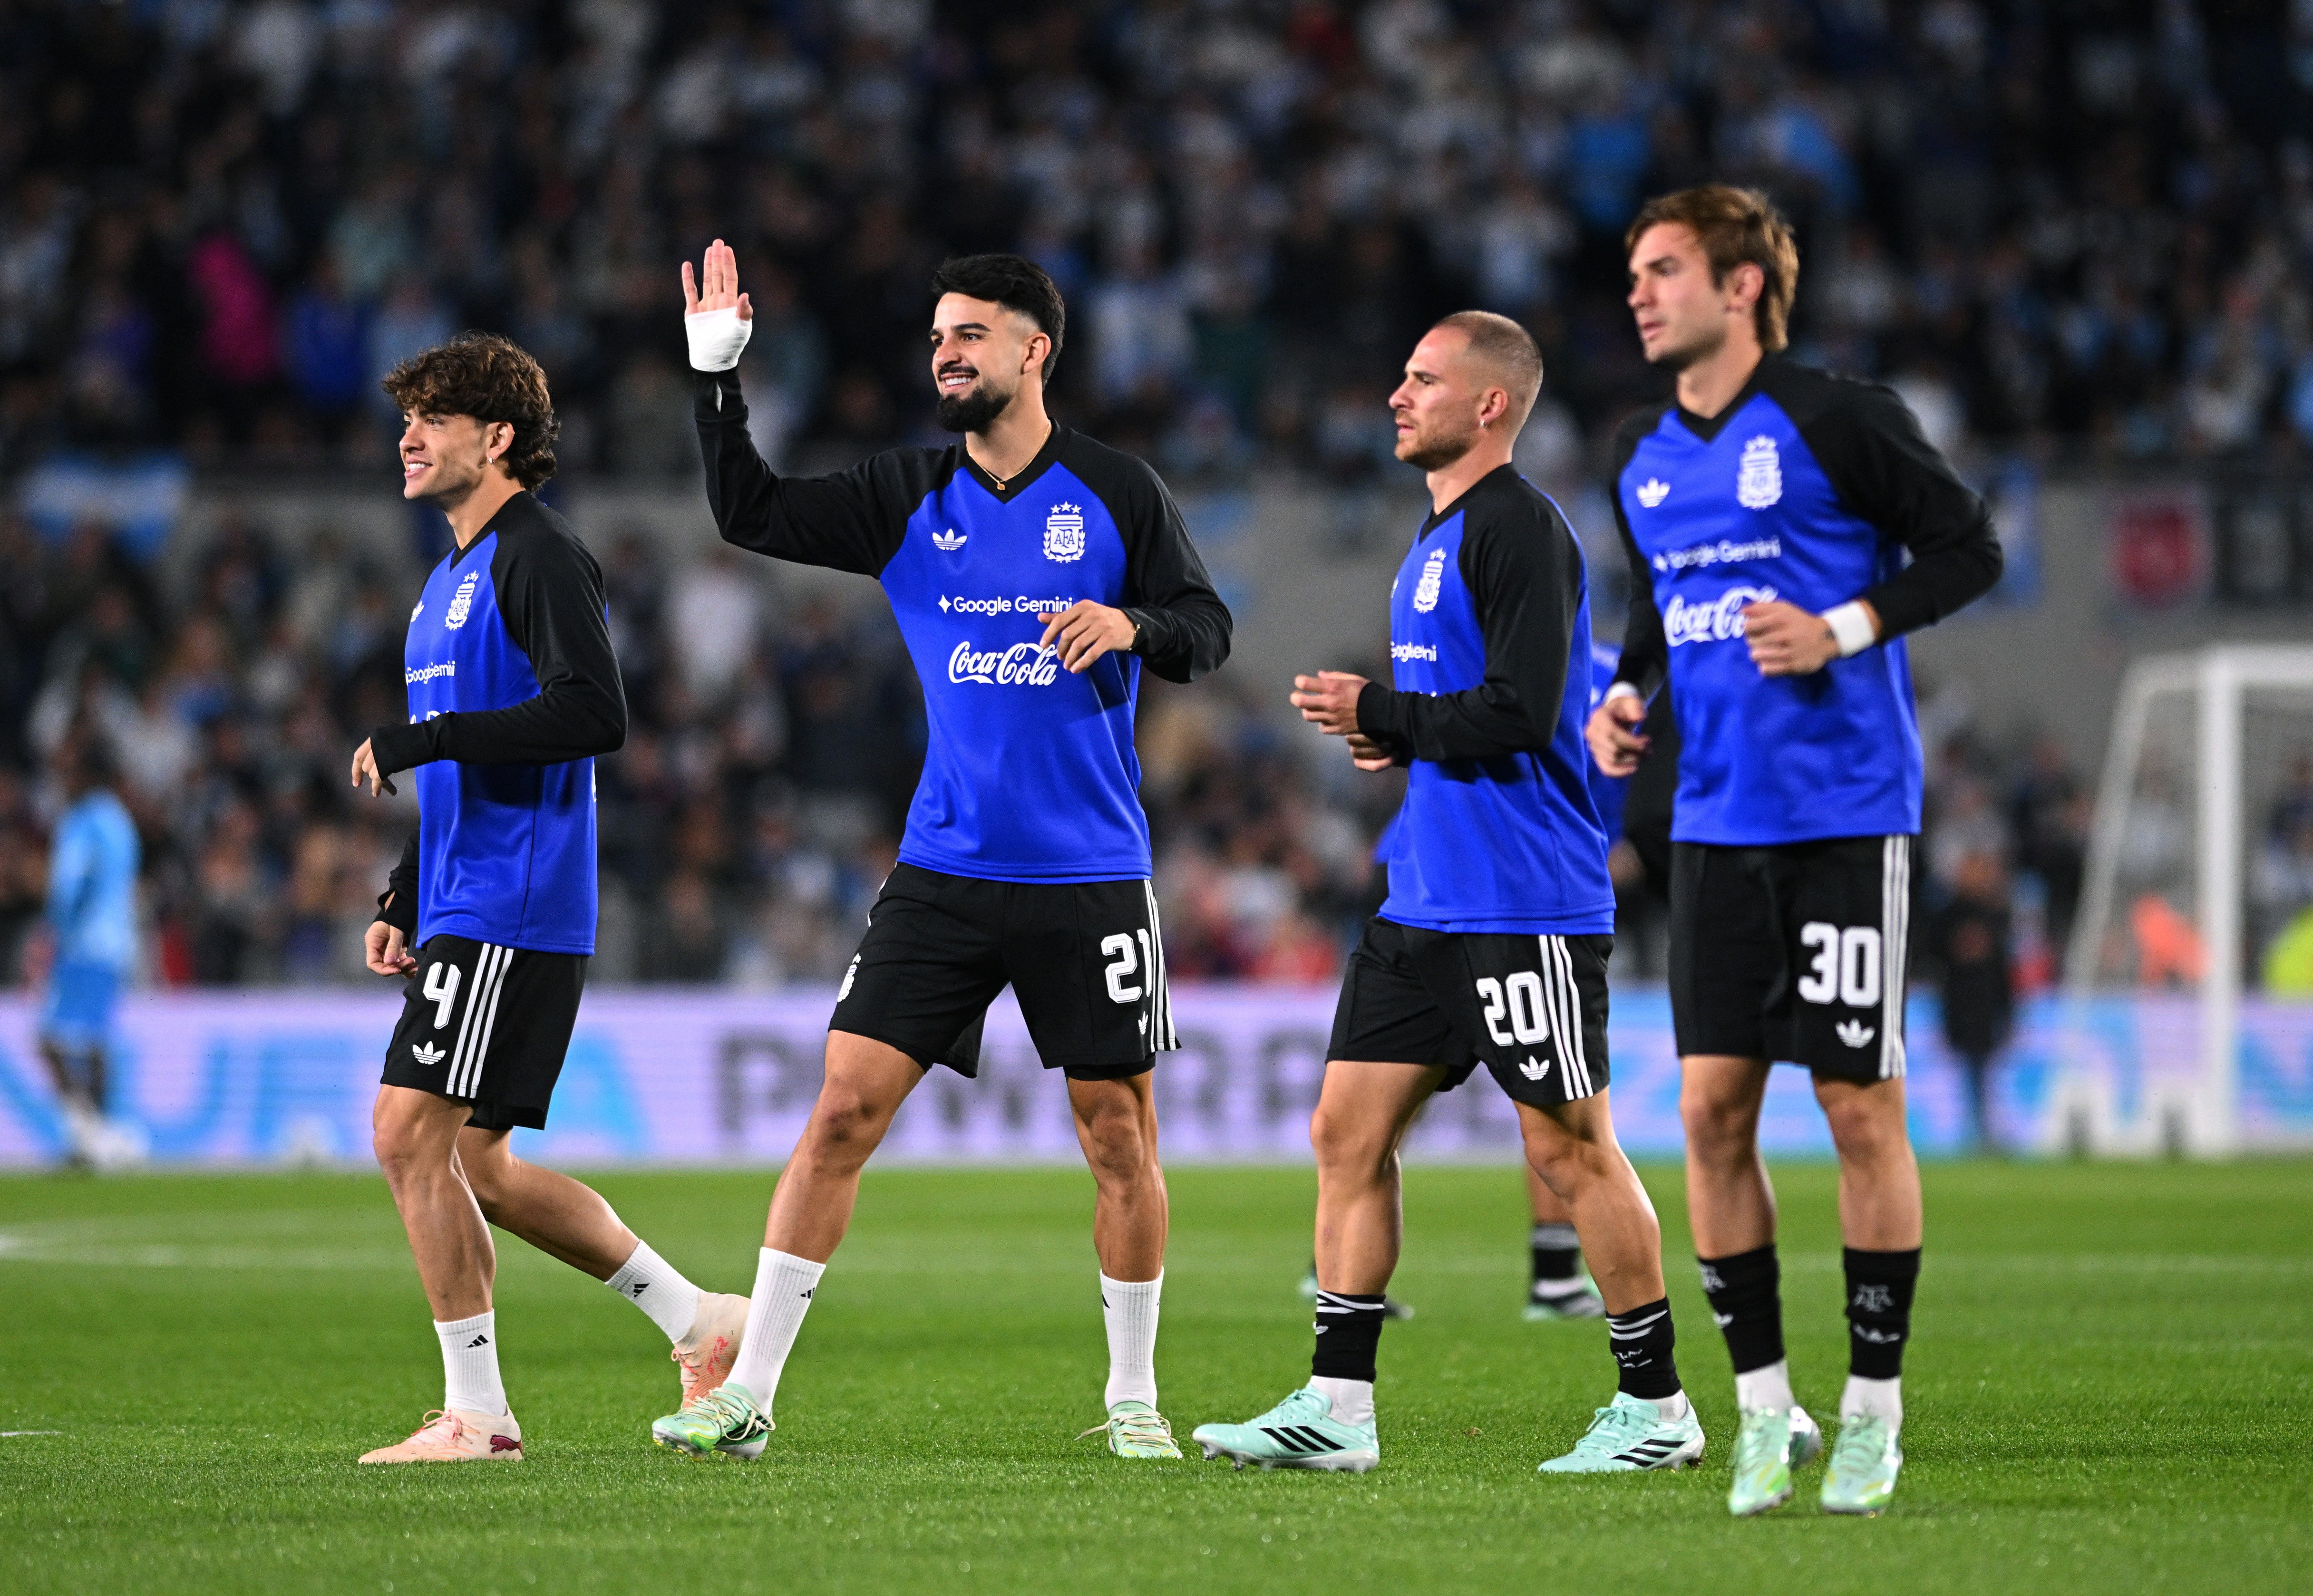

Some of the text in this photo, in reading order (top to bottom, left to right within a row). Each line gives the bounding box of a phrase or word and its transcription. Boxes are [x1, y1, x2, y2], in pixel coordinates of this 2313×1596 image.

[1054, 528, 1075, 548] AFA
[953, 596, 1073, 616] Google Gemini
[1663, 585, 1778, 647] Coca-Co
[949, 641, 1058, 686] Coca-Cola
[423, 962, 461, 1029] 4
[1100, 929, 1153, 1004] 21
[1798, 921, 1882, 1008] 30
[1476, 971, 1550, 1046] 20
